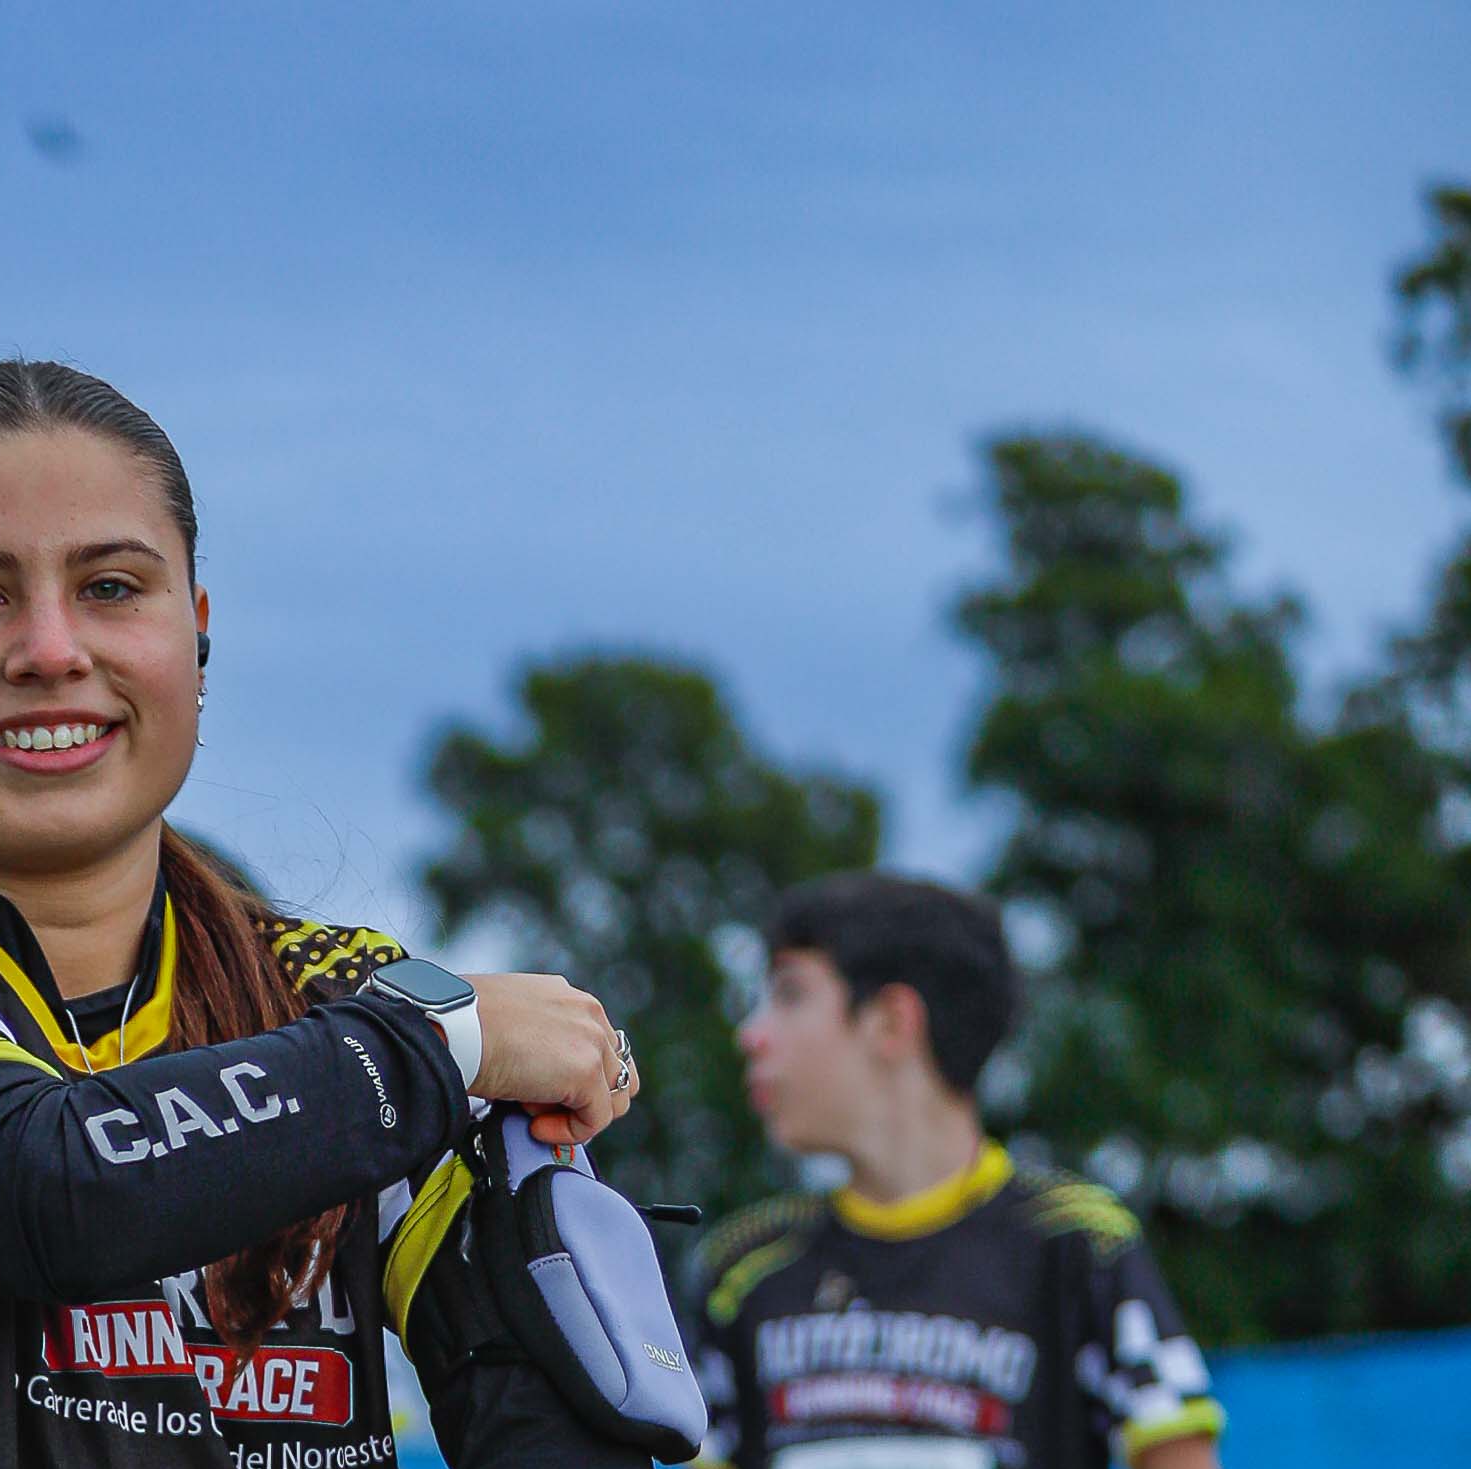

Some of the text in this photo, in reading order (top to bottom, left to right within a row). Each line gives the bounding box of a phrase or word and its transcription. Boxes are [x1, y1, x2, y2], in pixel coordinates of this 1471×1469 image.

[343, 1036, 387, 1103] WARM UP
[84, 1061, 301, 1165] C.A.C.
[194, 1353, 320, 1416] RACE
[641, 1342, 681, 1368] ONLY
[156, 1401, 202, 1436] los
